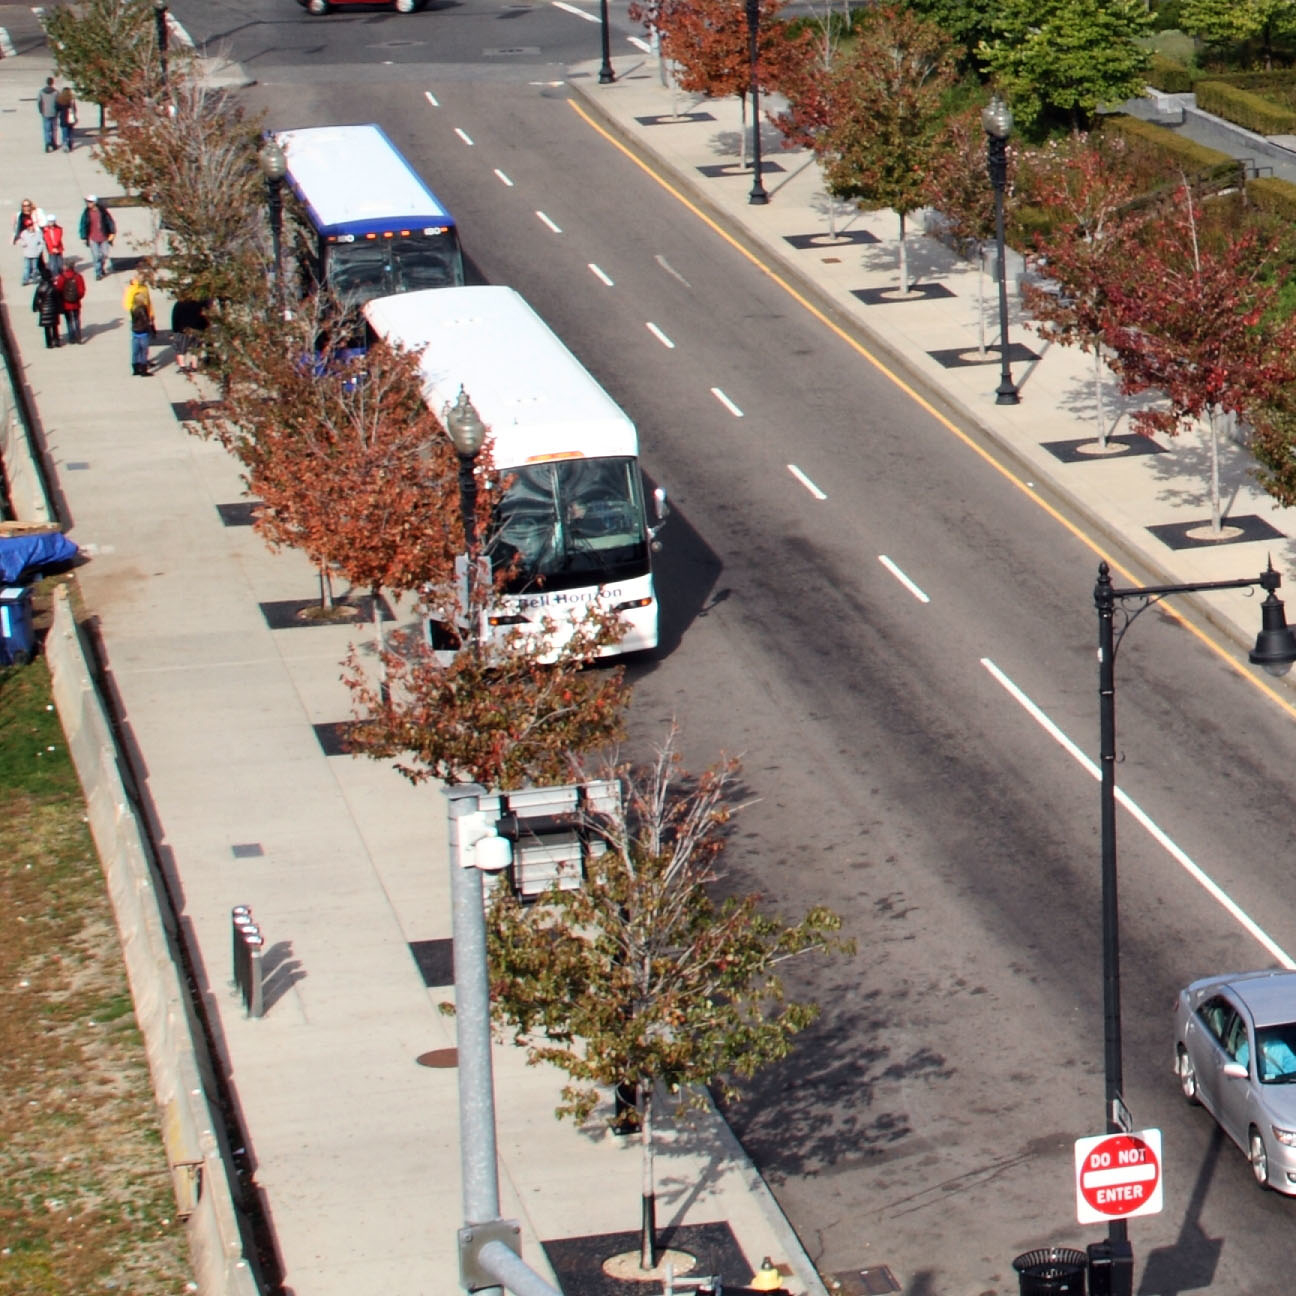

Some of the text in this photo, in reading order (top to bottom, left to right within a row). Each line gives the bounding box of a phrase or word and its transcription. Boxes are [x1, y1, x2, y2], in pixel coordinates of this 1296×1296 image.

[1090, 1148, 1146, 1169] DO NOT
[1096, 1184, 1143, 1204] ENTER
